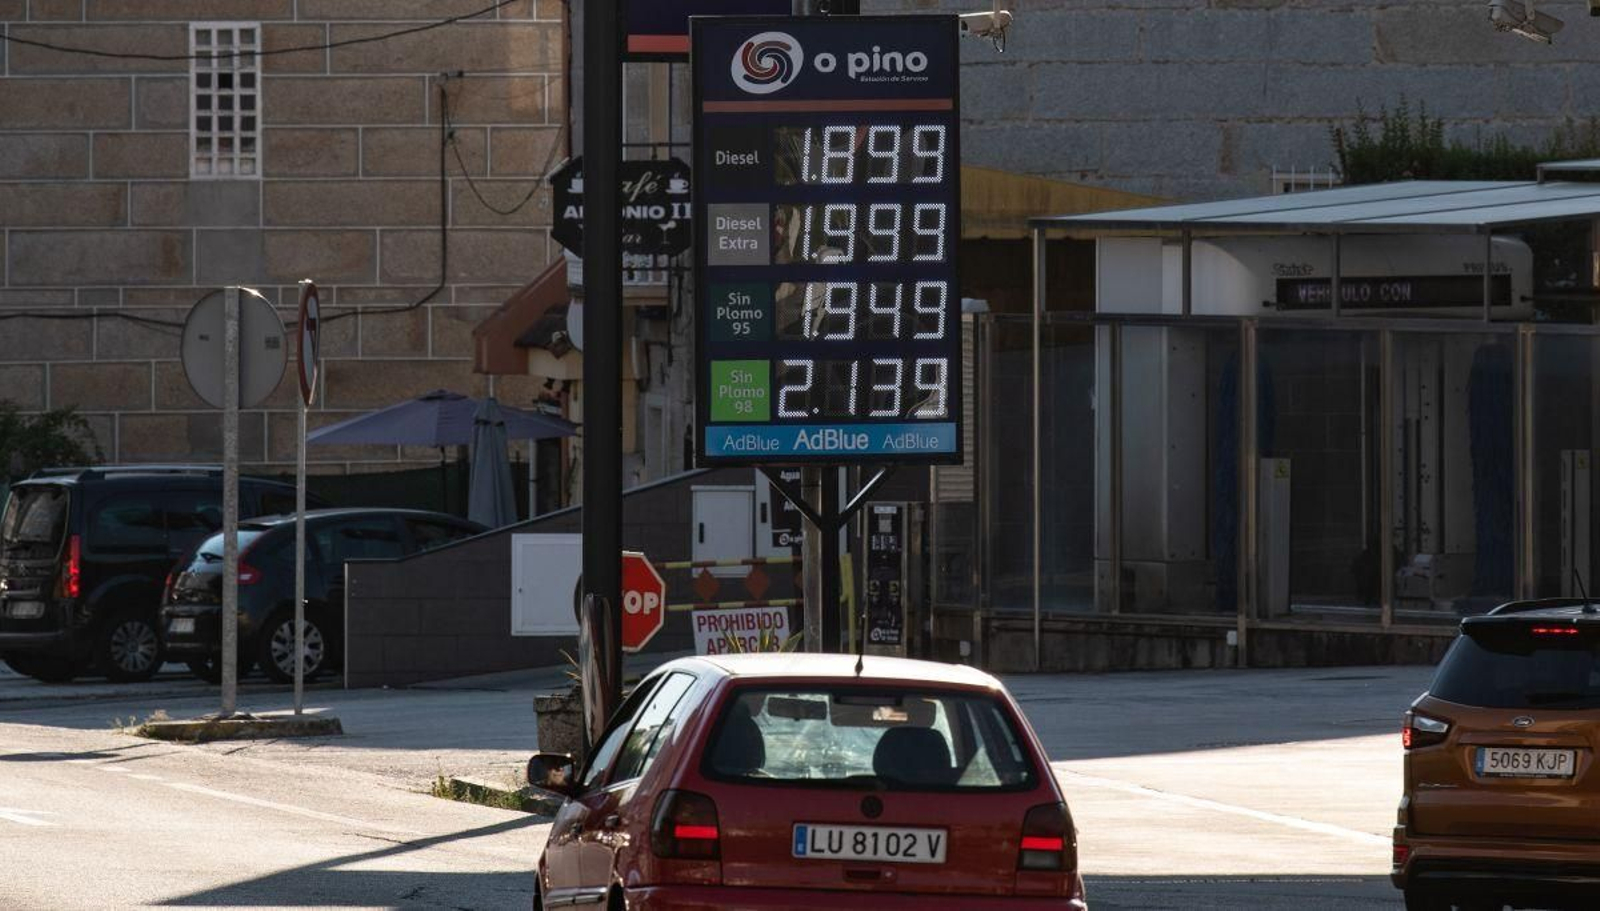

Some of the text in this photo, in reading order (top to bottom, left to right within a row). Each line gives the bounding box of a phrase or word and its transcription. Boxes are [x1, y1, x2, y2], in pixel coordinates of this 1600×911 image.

[814, 46, 928, 79] o pino
[715, 150, 759, 165] Diesel
[802, 125, 946, 183] 1.899
[716, 216, 762, 230] Diesel
[802, 203, 947, 262] 1.999
[719, 235, 758, 249] Extra
[728, 292, 750, 305] Sin
[1380, 282, 1412, 300] CON
[716, 306, 763, 320] Plomo
[803, 281, 947, 340] 1.949
[732, 322, 751, 335] 95
[730, 370, 753, 383] Sin
[719, 384, 765, 398] Plomo
[778, 358, 948, 418] 2.139
[735, 400, 753, 413] 98
[723, 429, 939, 450] AdBlue AdBlue AdBlue
[622, 590, 660, 615] OP
[696, 611, 784, 632] PROHIBIDO
[1490, 751, 1567, 770] 5069 KJP
[810, 829, 844, 854] LU
[852, 831, 918, 857] 8102
[927, 834, 941, 859] V
